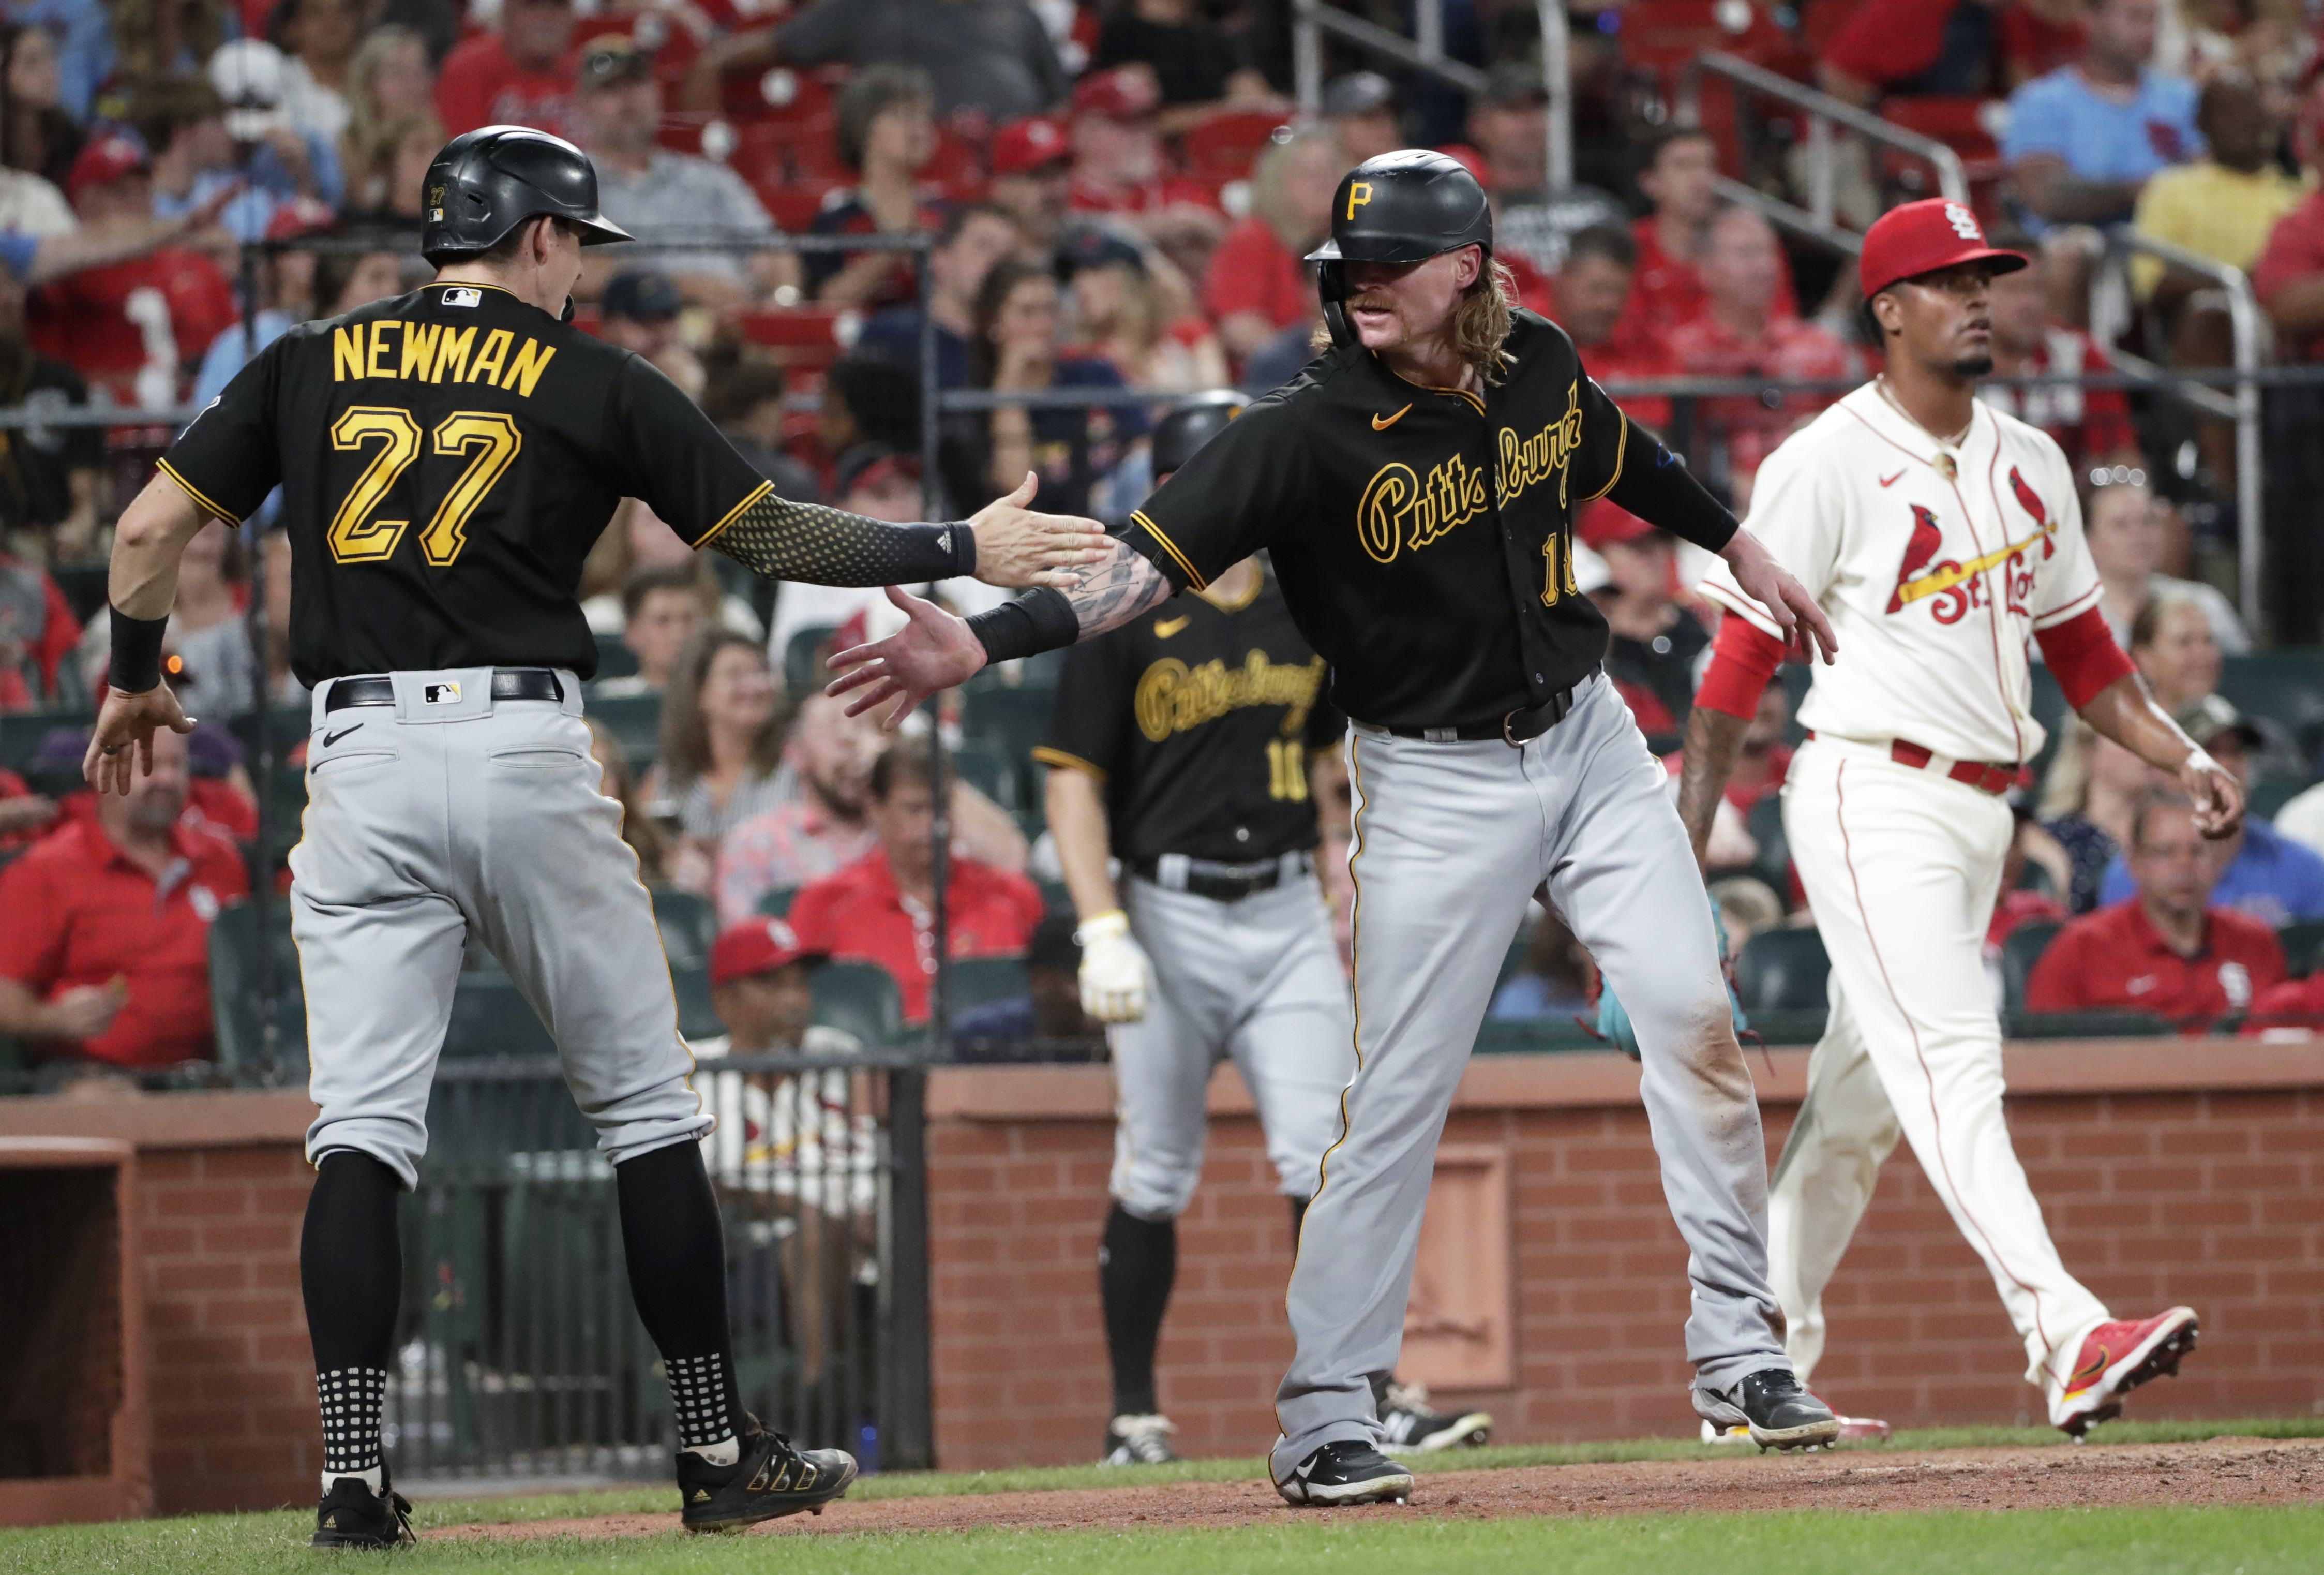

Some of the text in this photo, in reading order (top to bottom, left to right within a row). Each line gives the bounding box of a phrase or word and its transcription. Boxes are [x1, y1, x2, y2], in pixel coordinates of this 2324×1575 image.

[431, 187, 445, 205] 27
[1347, 182, 1373, 220] P
[334, 320, 557, 398] NEWMAN
[327, 405, 522, 567] 27
[1264, 737, 1309, 804] 11
